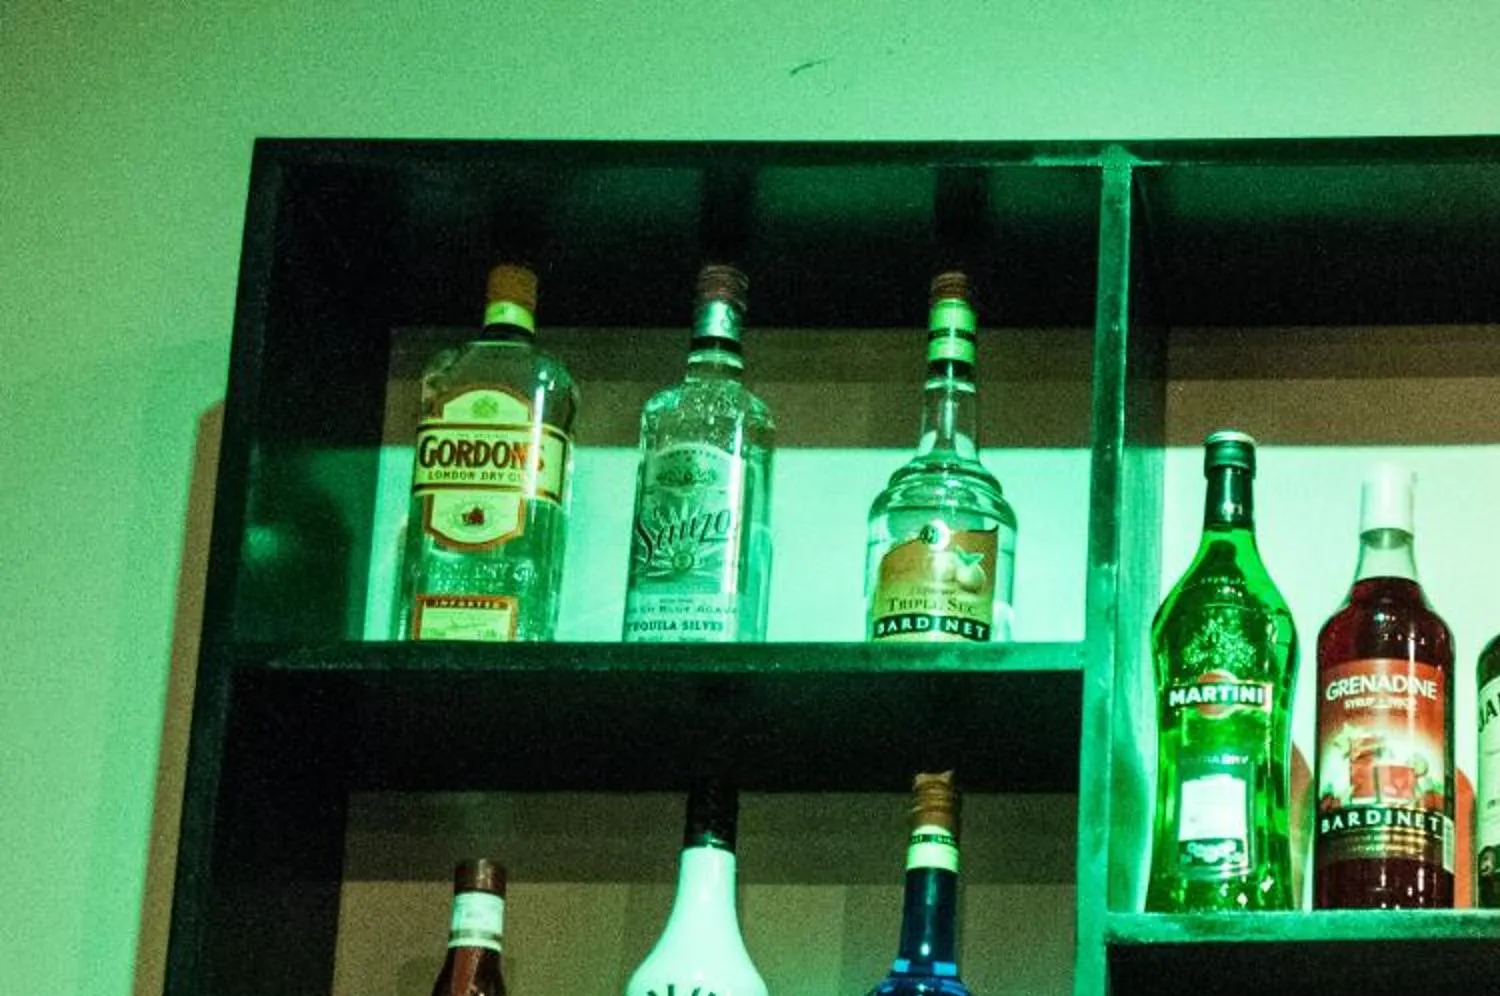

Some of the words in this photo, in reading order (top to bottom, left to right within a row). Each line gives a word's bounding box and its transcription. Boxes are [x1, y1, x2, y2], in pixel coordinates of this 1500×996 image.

[420, 436, 545, 472] GORDONS
[876, 616, 987, 640] BARDINET
[1168, 685, 1266, 707] MARTINI
[1325, 673, 1438, 701] GRENADINE
[1320, 808, 1441, 834] BARDINET
